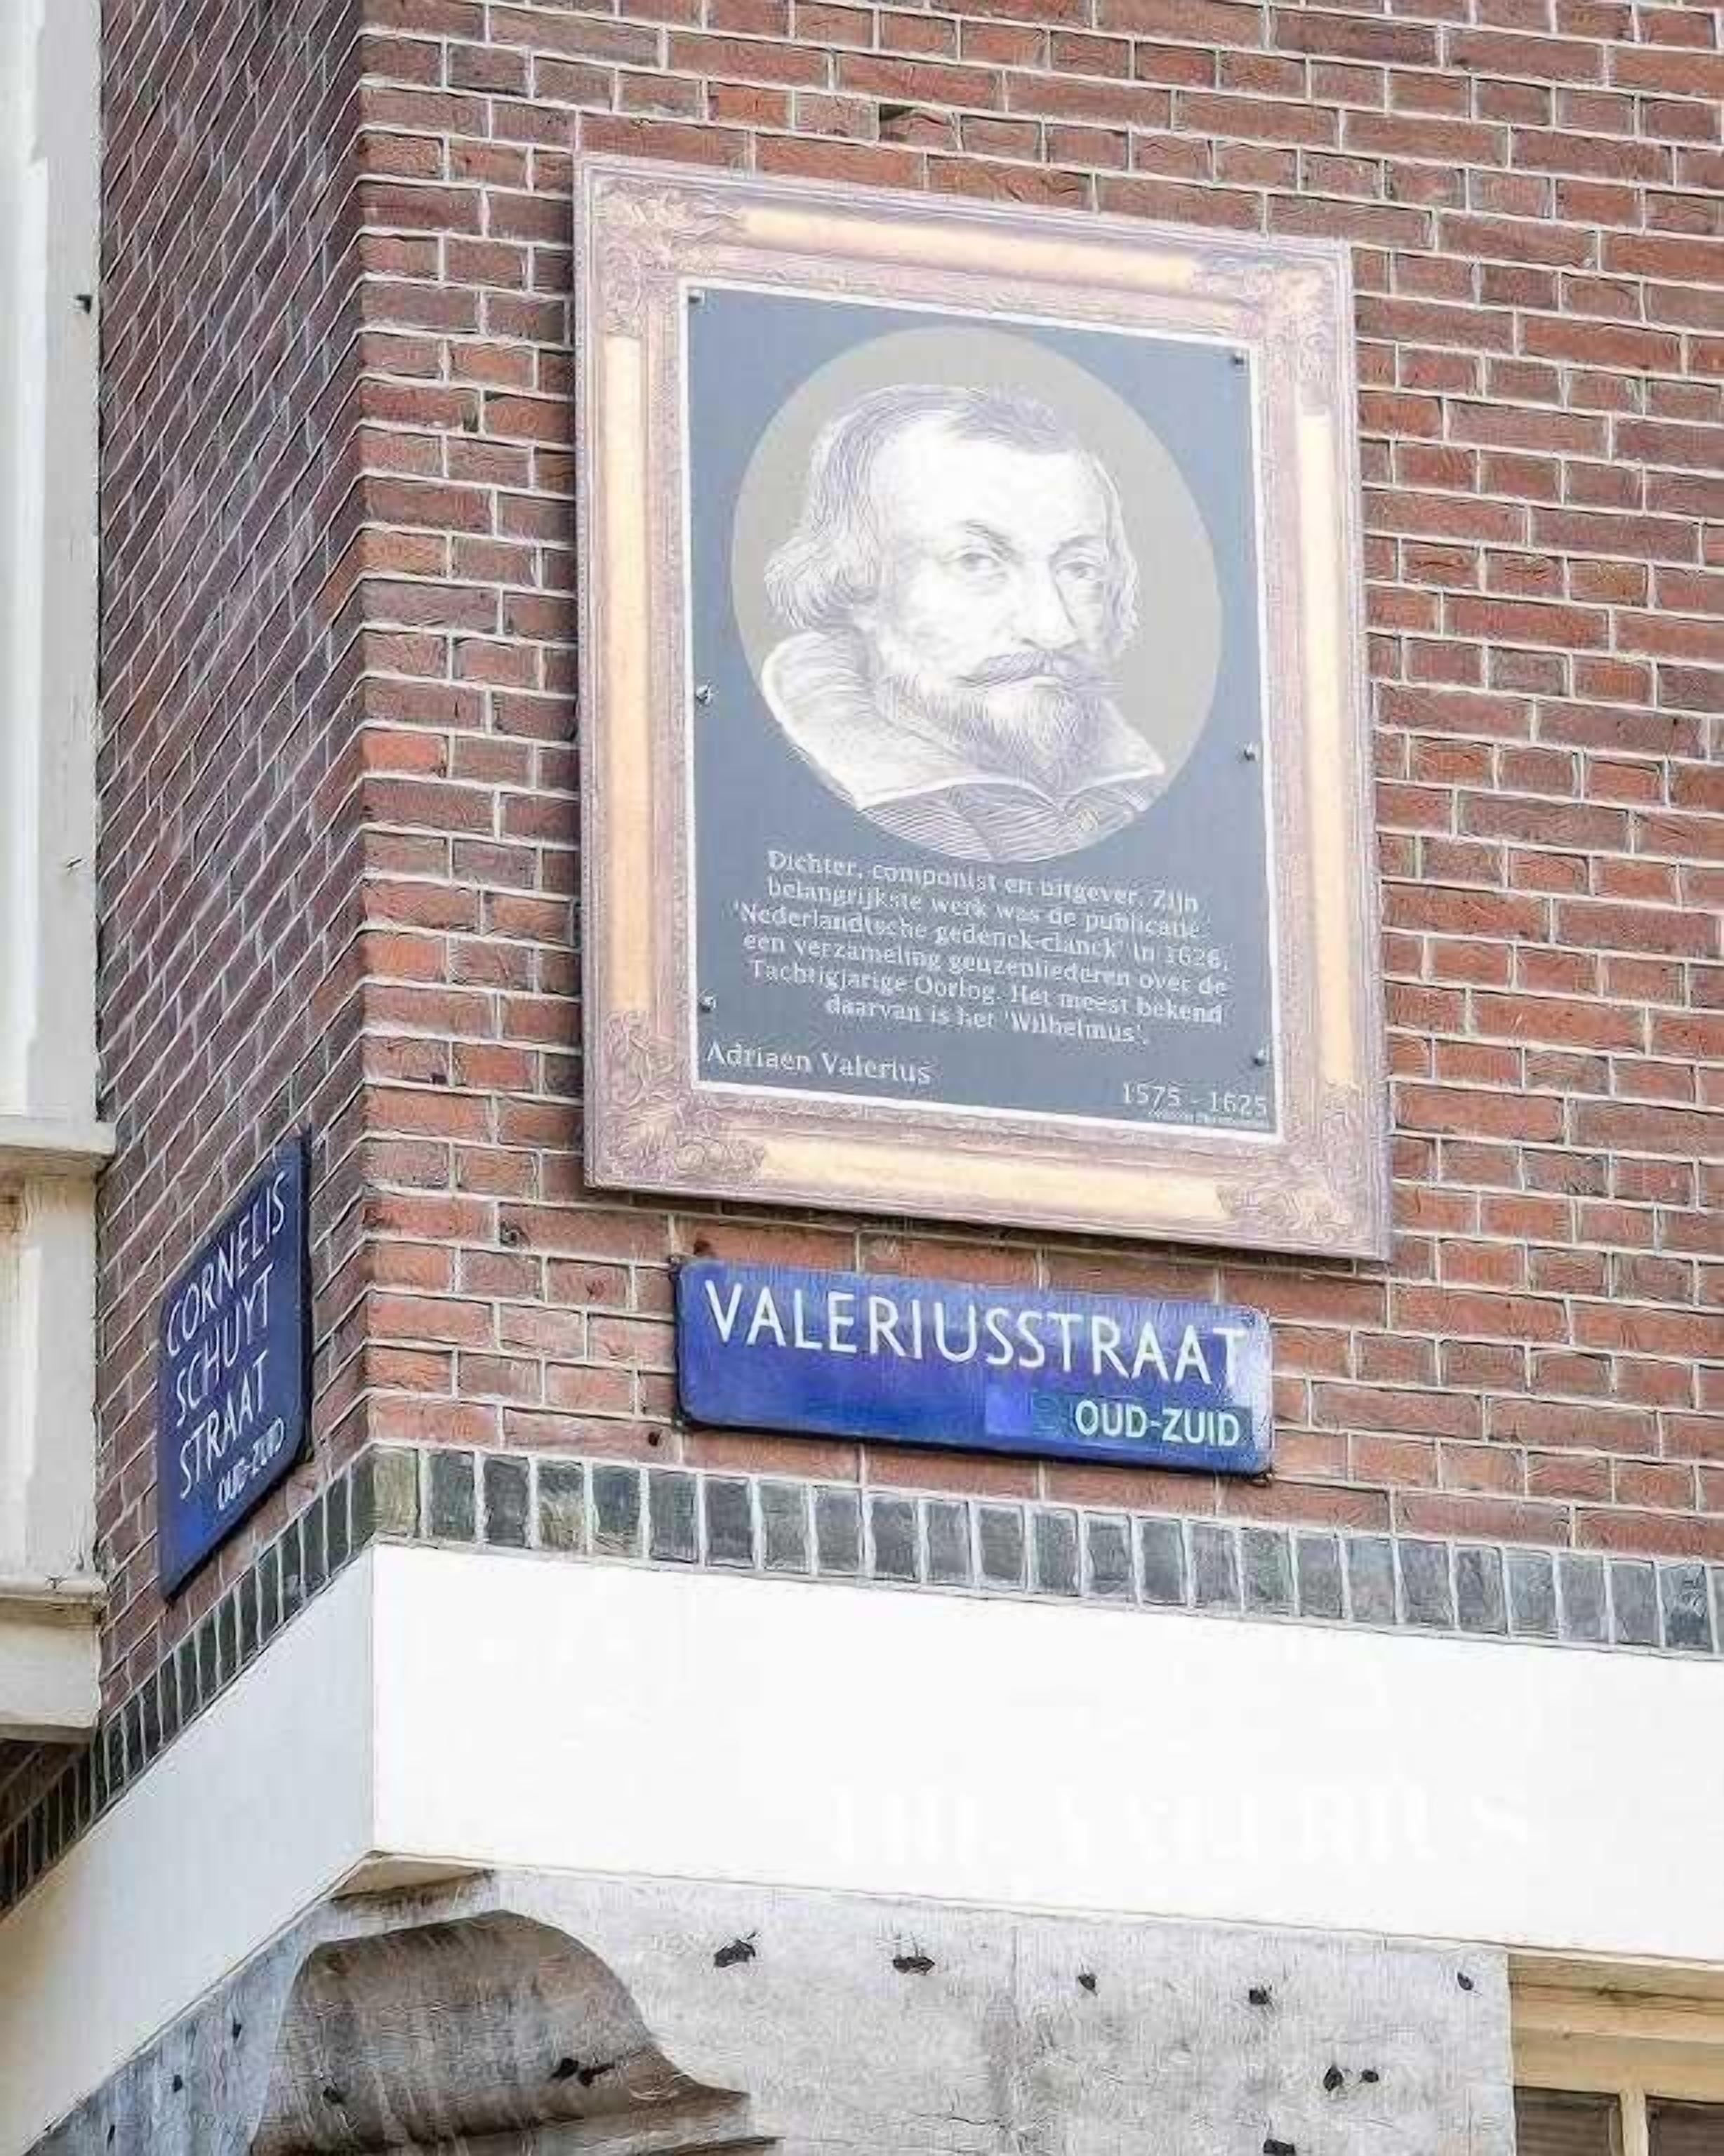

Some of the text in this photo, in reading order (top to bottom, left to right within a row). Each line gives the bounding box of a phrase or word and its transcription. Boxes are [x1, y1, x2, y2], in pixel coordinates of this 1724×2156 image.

[768, 850, 862, 879] Dichter,
[873, 864, 997, 892] componist
[1005, 877, 1033, 896] en
[768, 875, 922, 910] belangrijkste
[931, 897, 986, 918] werk
[996, 904, 1040, 922] was
[1049, 906, 1076, 927] de
[743, 934, 1226, 997] een verzameling geuzenliederen over de
[1134, 943, 1155, 962] in
[750, 959, 906, 997] Tachtigjarige
[1011, 984, 1050, 1007] Het
[1059, 992, 1128, 1014] meest
[1136, 996, 1223, 1024] bekend
[825, 994, 922, 1022] daarvan
[931, 1005, 949, 1025] is
[957, 1005, 993, 1028] het
[707, 1040, 931, 1085] Adriaen Valerius
[1124, 1082, 1181, 1114] 1575
[1210, 1091, 1268, 1117] 1625
[167, 1170, 286, 1357] CORNELIS
[176, 1263, 274, 1427] SCHUYT
[704, 1279, 1249, 1388] VALERIUSSTRAAT
[180, 1349, 268, 1500] STRAAT
[1075, 1399, 1240, 1446] OUD-ZUID
